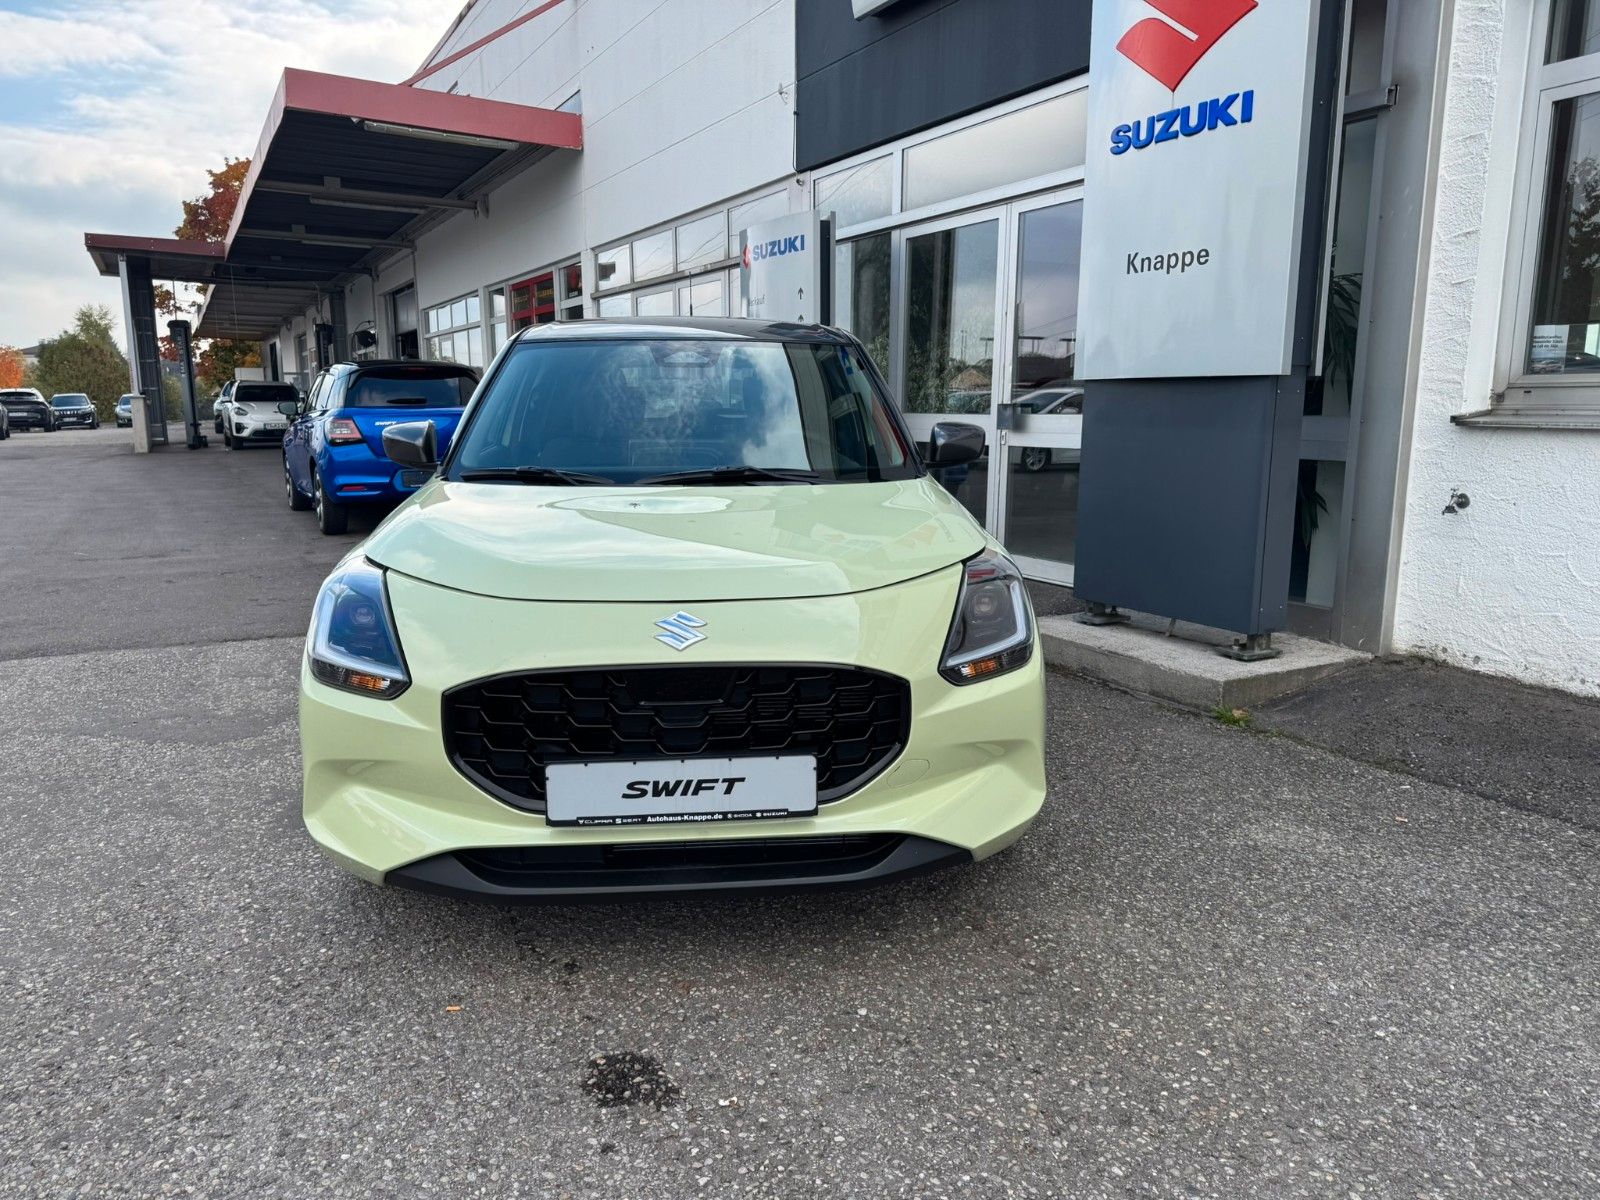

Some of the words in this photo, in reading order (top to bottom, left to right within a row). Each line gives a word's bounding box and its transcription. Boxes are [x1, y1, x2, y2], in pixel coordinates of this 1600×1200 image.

[1110, 89, 1254, 155] SUZUKI
[752, 234, 805, 262] SUZUKI
[1126, 248, 1210, 275] Knappe
[621, 777, 746, 799] SWIFT
[647, 813, 723, 823] Autohaus-Knappe.de
